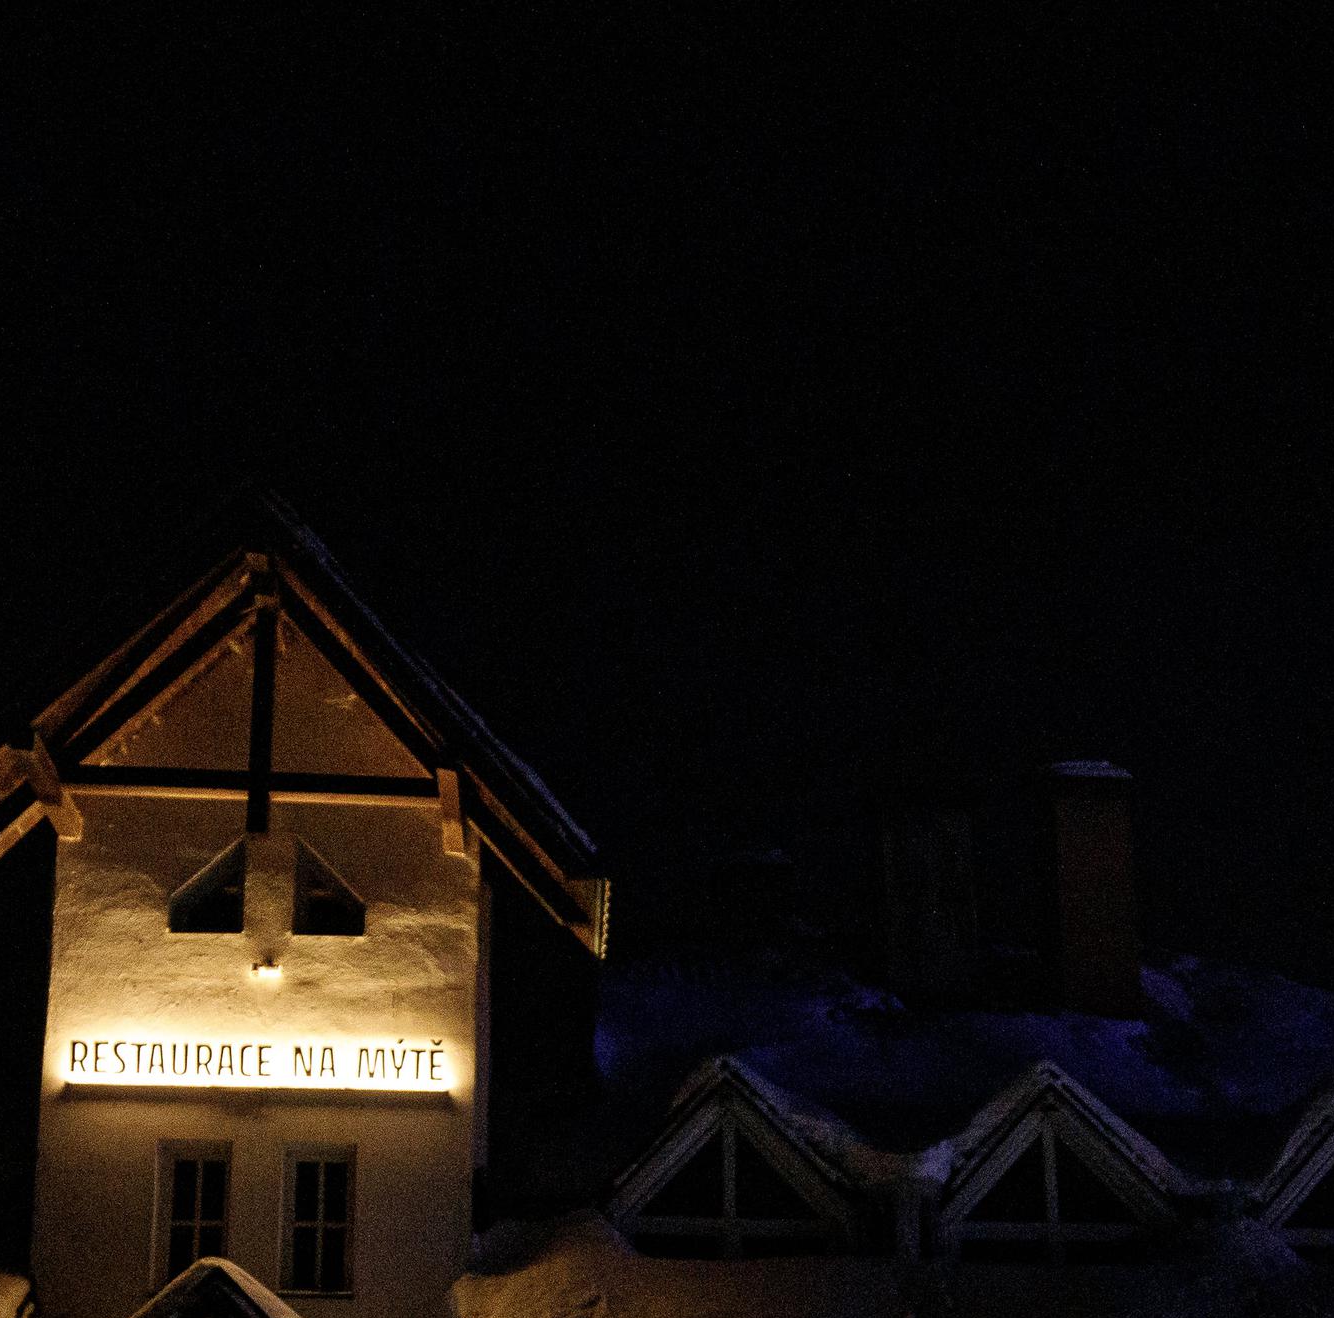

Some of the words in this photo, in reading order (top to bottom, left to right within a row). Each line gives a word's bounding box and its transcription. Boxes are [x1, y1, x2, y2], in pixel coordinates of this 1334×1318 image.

[69, 1039, 272, 1077] RESTAURACE
[294, 1046, 336, 1078] NA
[357, 1038, 445, 1081] MÝTĚ
